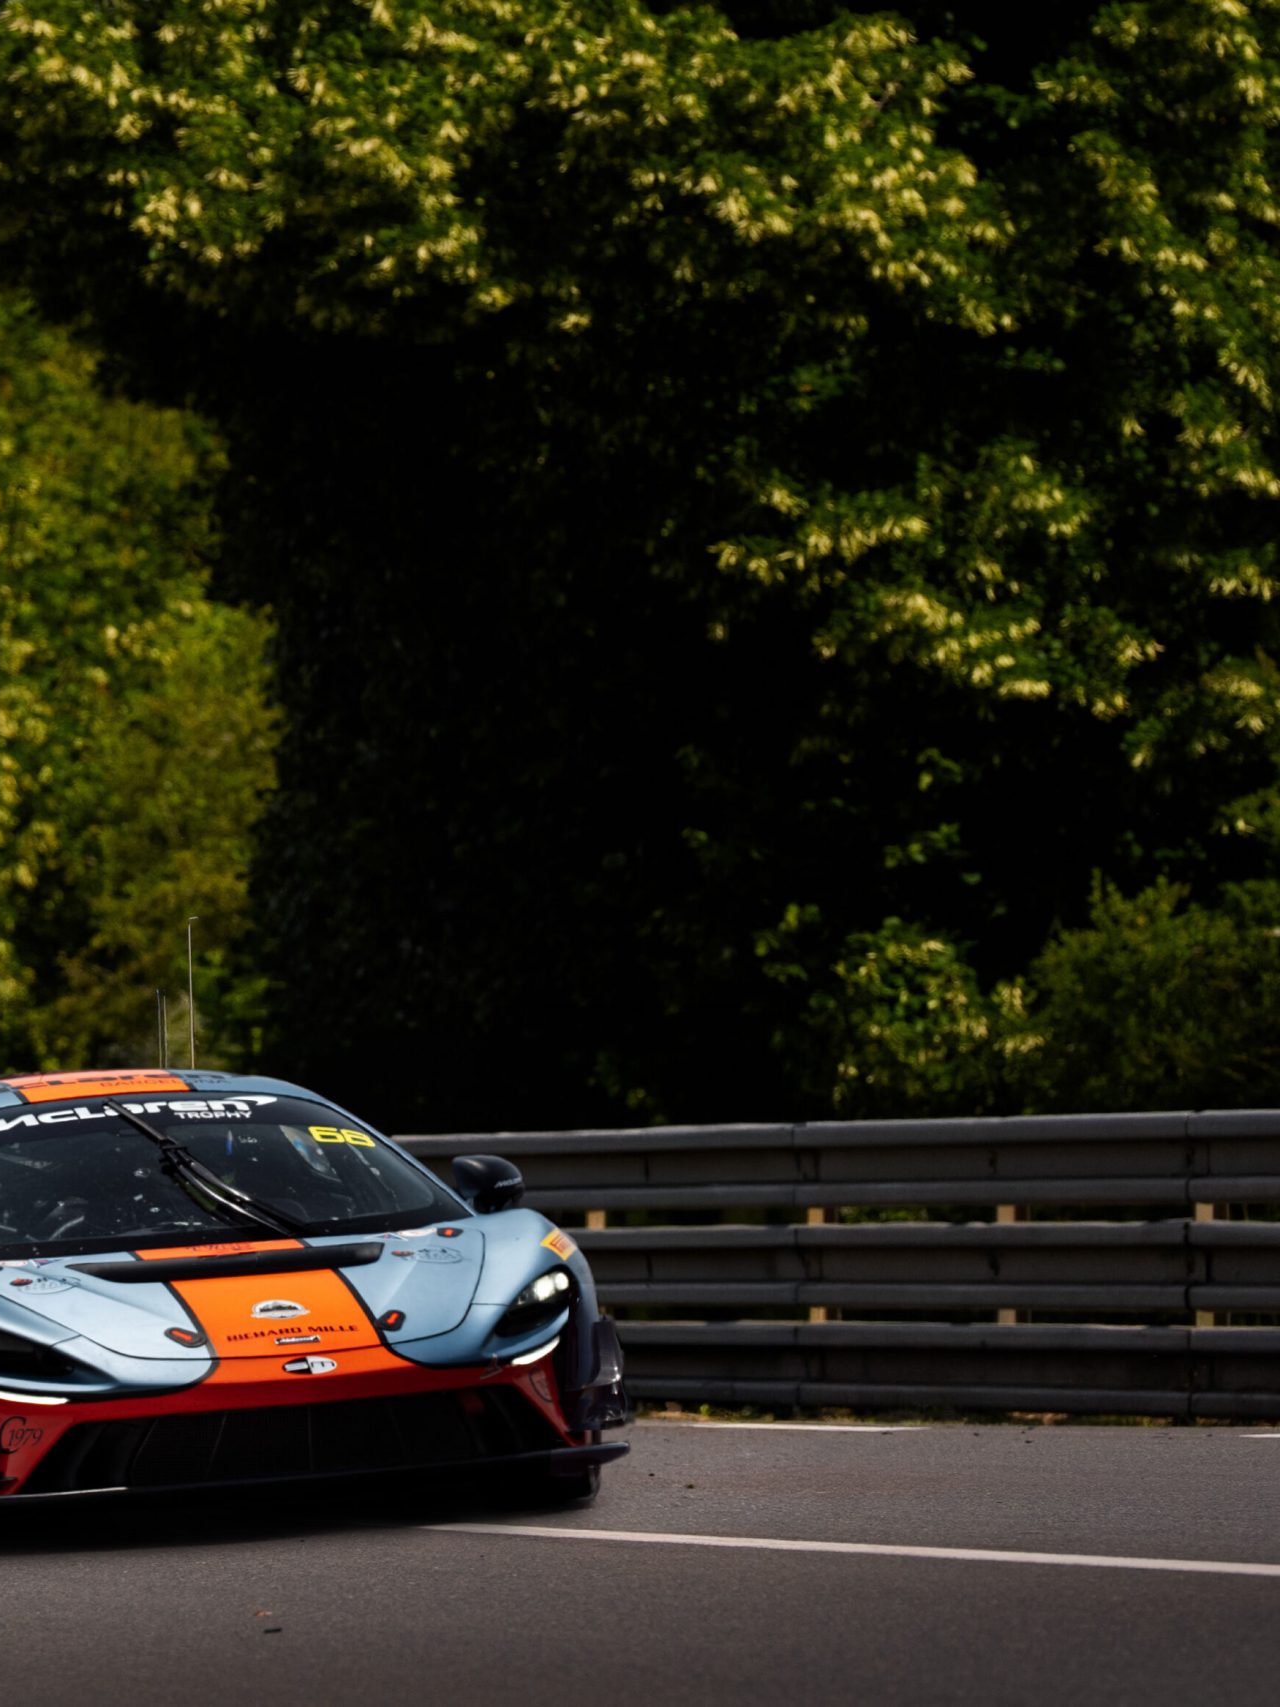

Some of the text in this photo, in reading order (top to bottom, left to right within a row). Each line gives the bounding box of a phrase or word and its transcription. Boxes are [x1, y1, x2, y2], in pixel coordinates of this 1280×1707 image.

[173, 1111, 252, 1120] TROPHY
[227, 1327, 302, 1342] RICHARD
[308, 1325, 359, 1333] MILLE
[9, 1427, 44, 1447] 1979
